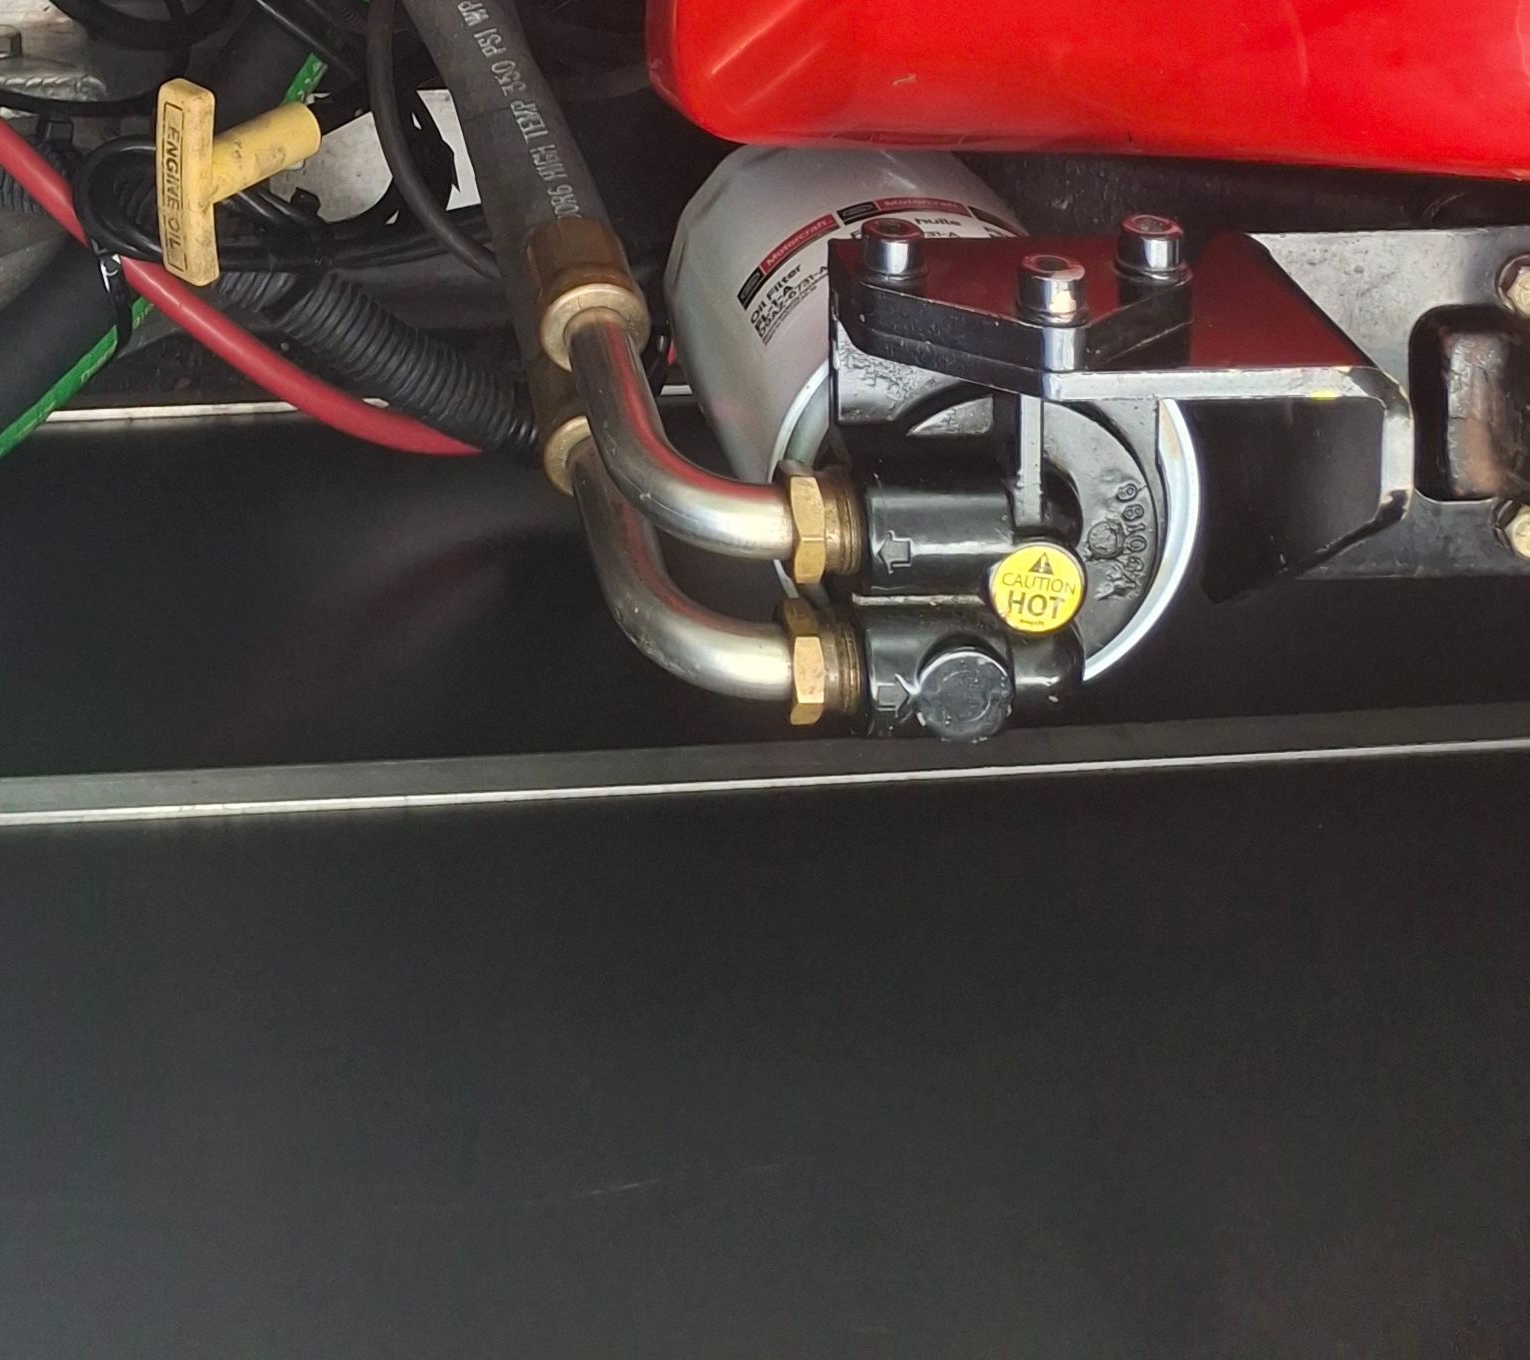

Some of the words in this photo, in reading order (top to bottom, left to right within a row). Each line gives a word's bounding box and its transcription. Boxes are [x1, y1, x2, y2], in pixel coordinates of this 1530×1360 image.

[457, 0, 490, 27] WP
[473, 30, 507, 57] PSI
[510, 99, 550, 144] TEMP
[166, 127, 180, 210] ENGINE
[529, 143, 568, 181] HIGH
[167, 218, 181, 251] OIL
[750, 300, 767, 324] Oil
[766, 263, 802, 301] Filter
[1002, 572, 1076, 595] CAUTION
[1008, 590, 1066, 619] HOT
